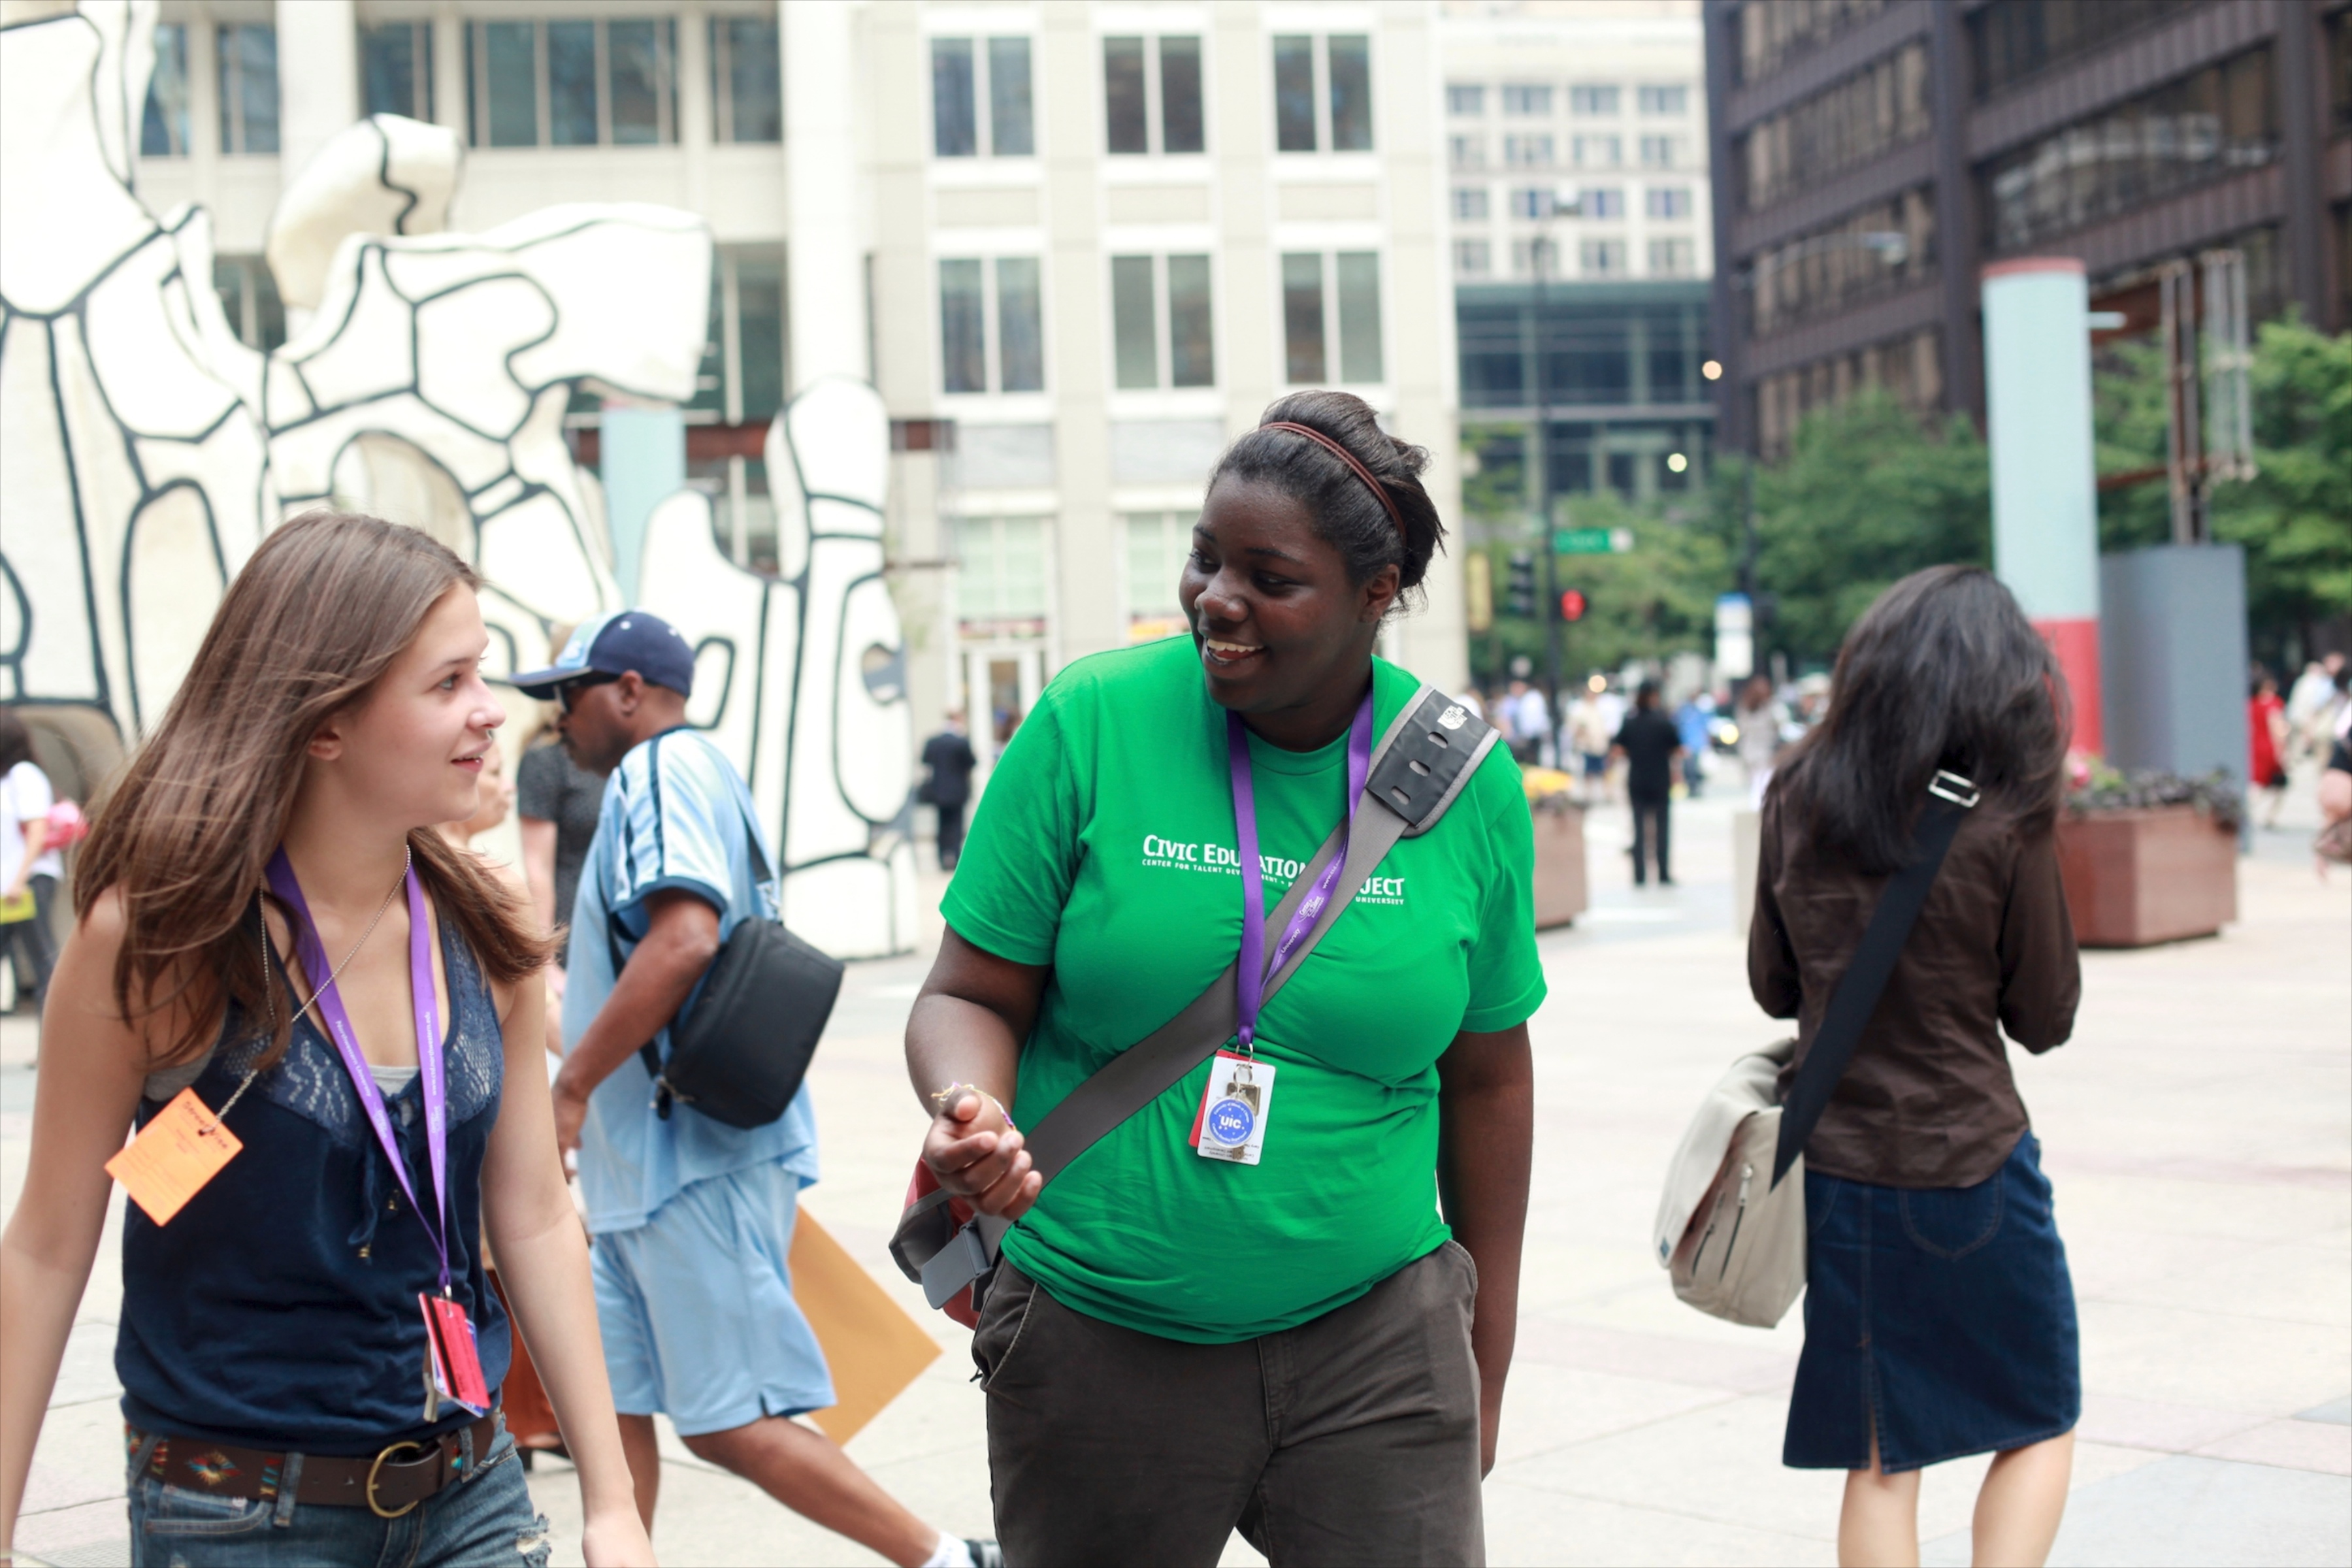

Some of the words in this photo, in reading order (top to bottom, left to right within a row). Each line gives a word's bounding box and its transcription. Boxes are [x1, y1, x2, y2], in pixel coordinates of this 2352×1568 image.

[1142, 858, 1171, 868] CENTER
[1193, 864, 1222, 873] TALENT
[1355, 896, 1404, 905] UNIVERSITY
[1203, 843, 1306, 879] EDUATIO
[1360, 877, 1405, 896] JECT
[1281, 928, 1301, 953] University
[1220, 1116, 1241, 1129] UIC
